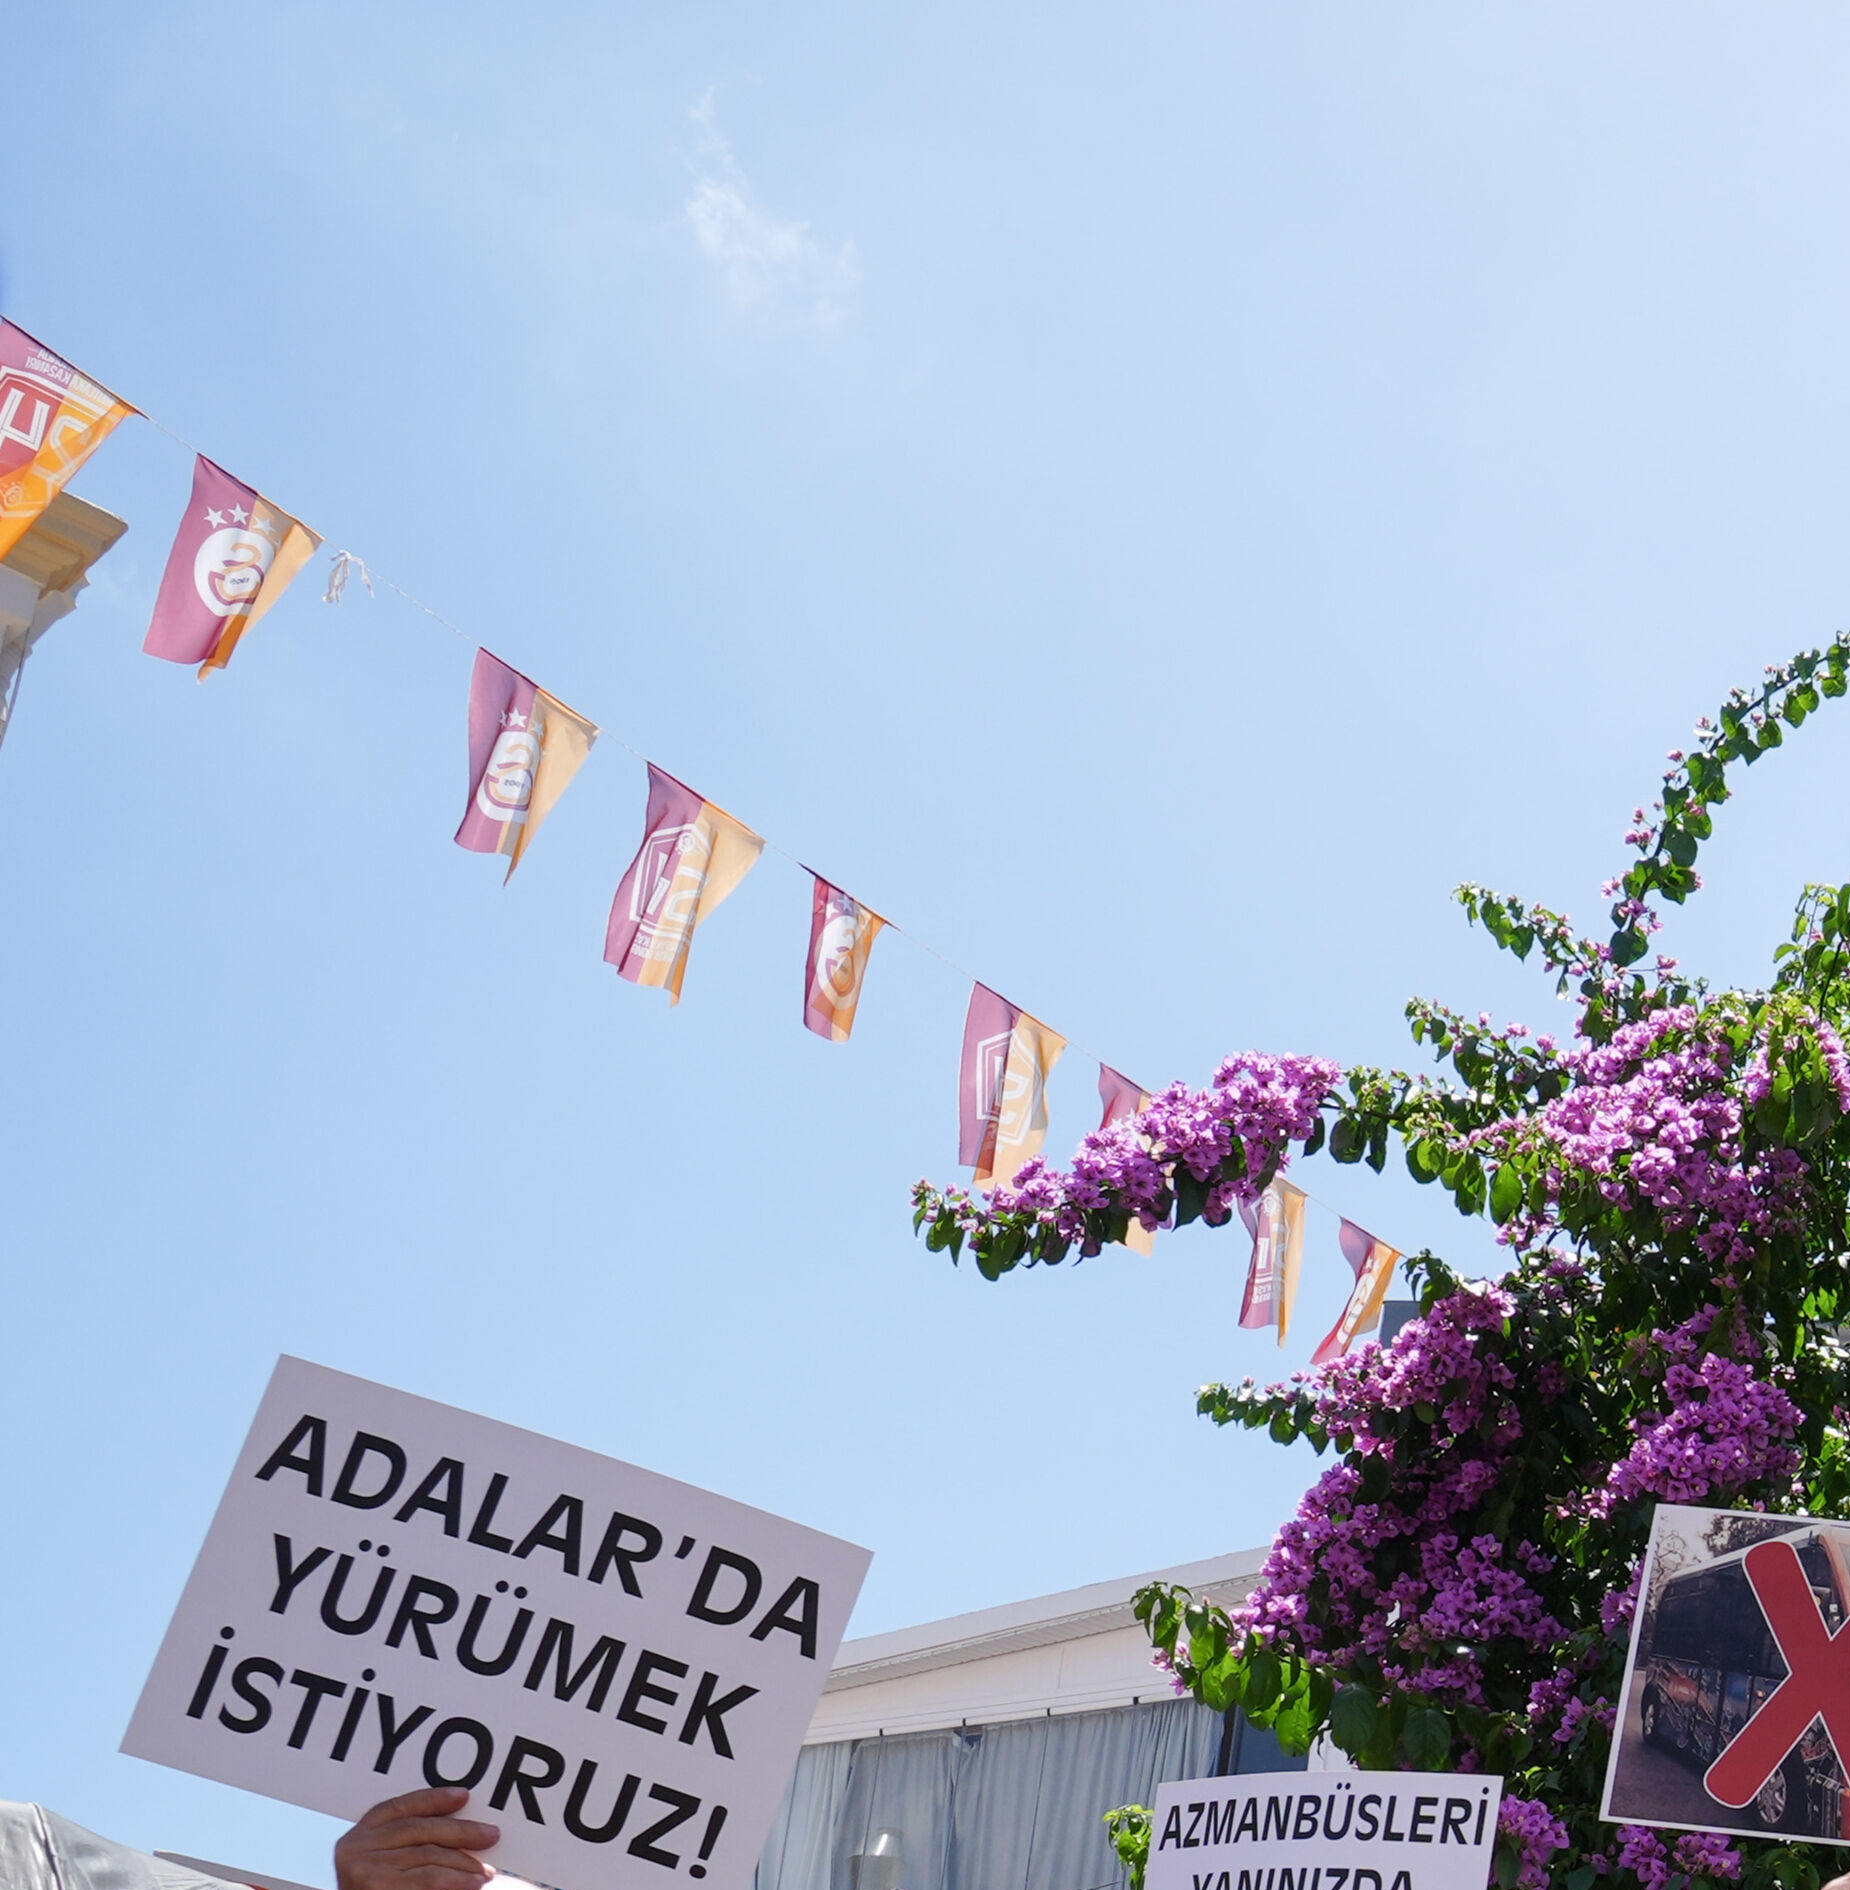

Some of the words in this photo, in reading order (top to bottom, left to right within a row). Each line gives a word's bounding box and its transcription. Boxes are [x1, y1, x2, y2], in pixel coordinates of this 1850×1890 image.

[255, 1413, 821, 1660] ADALAR'DA
[268, 1533, 760, 1760] YÜRÜMEK
[186, 1626, 728, 1880] İSTİYORUZ!
[1158, 1782, 1490, 1851] AZMANBÜSLERİ
